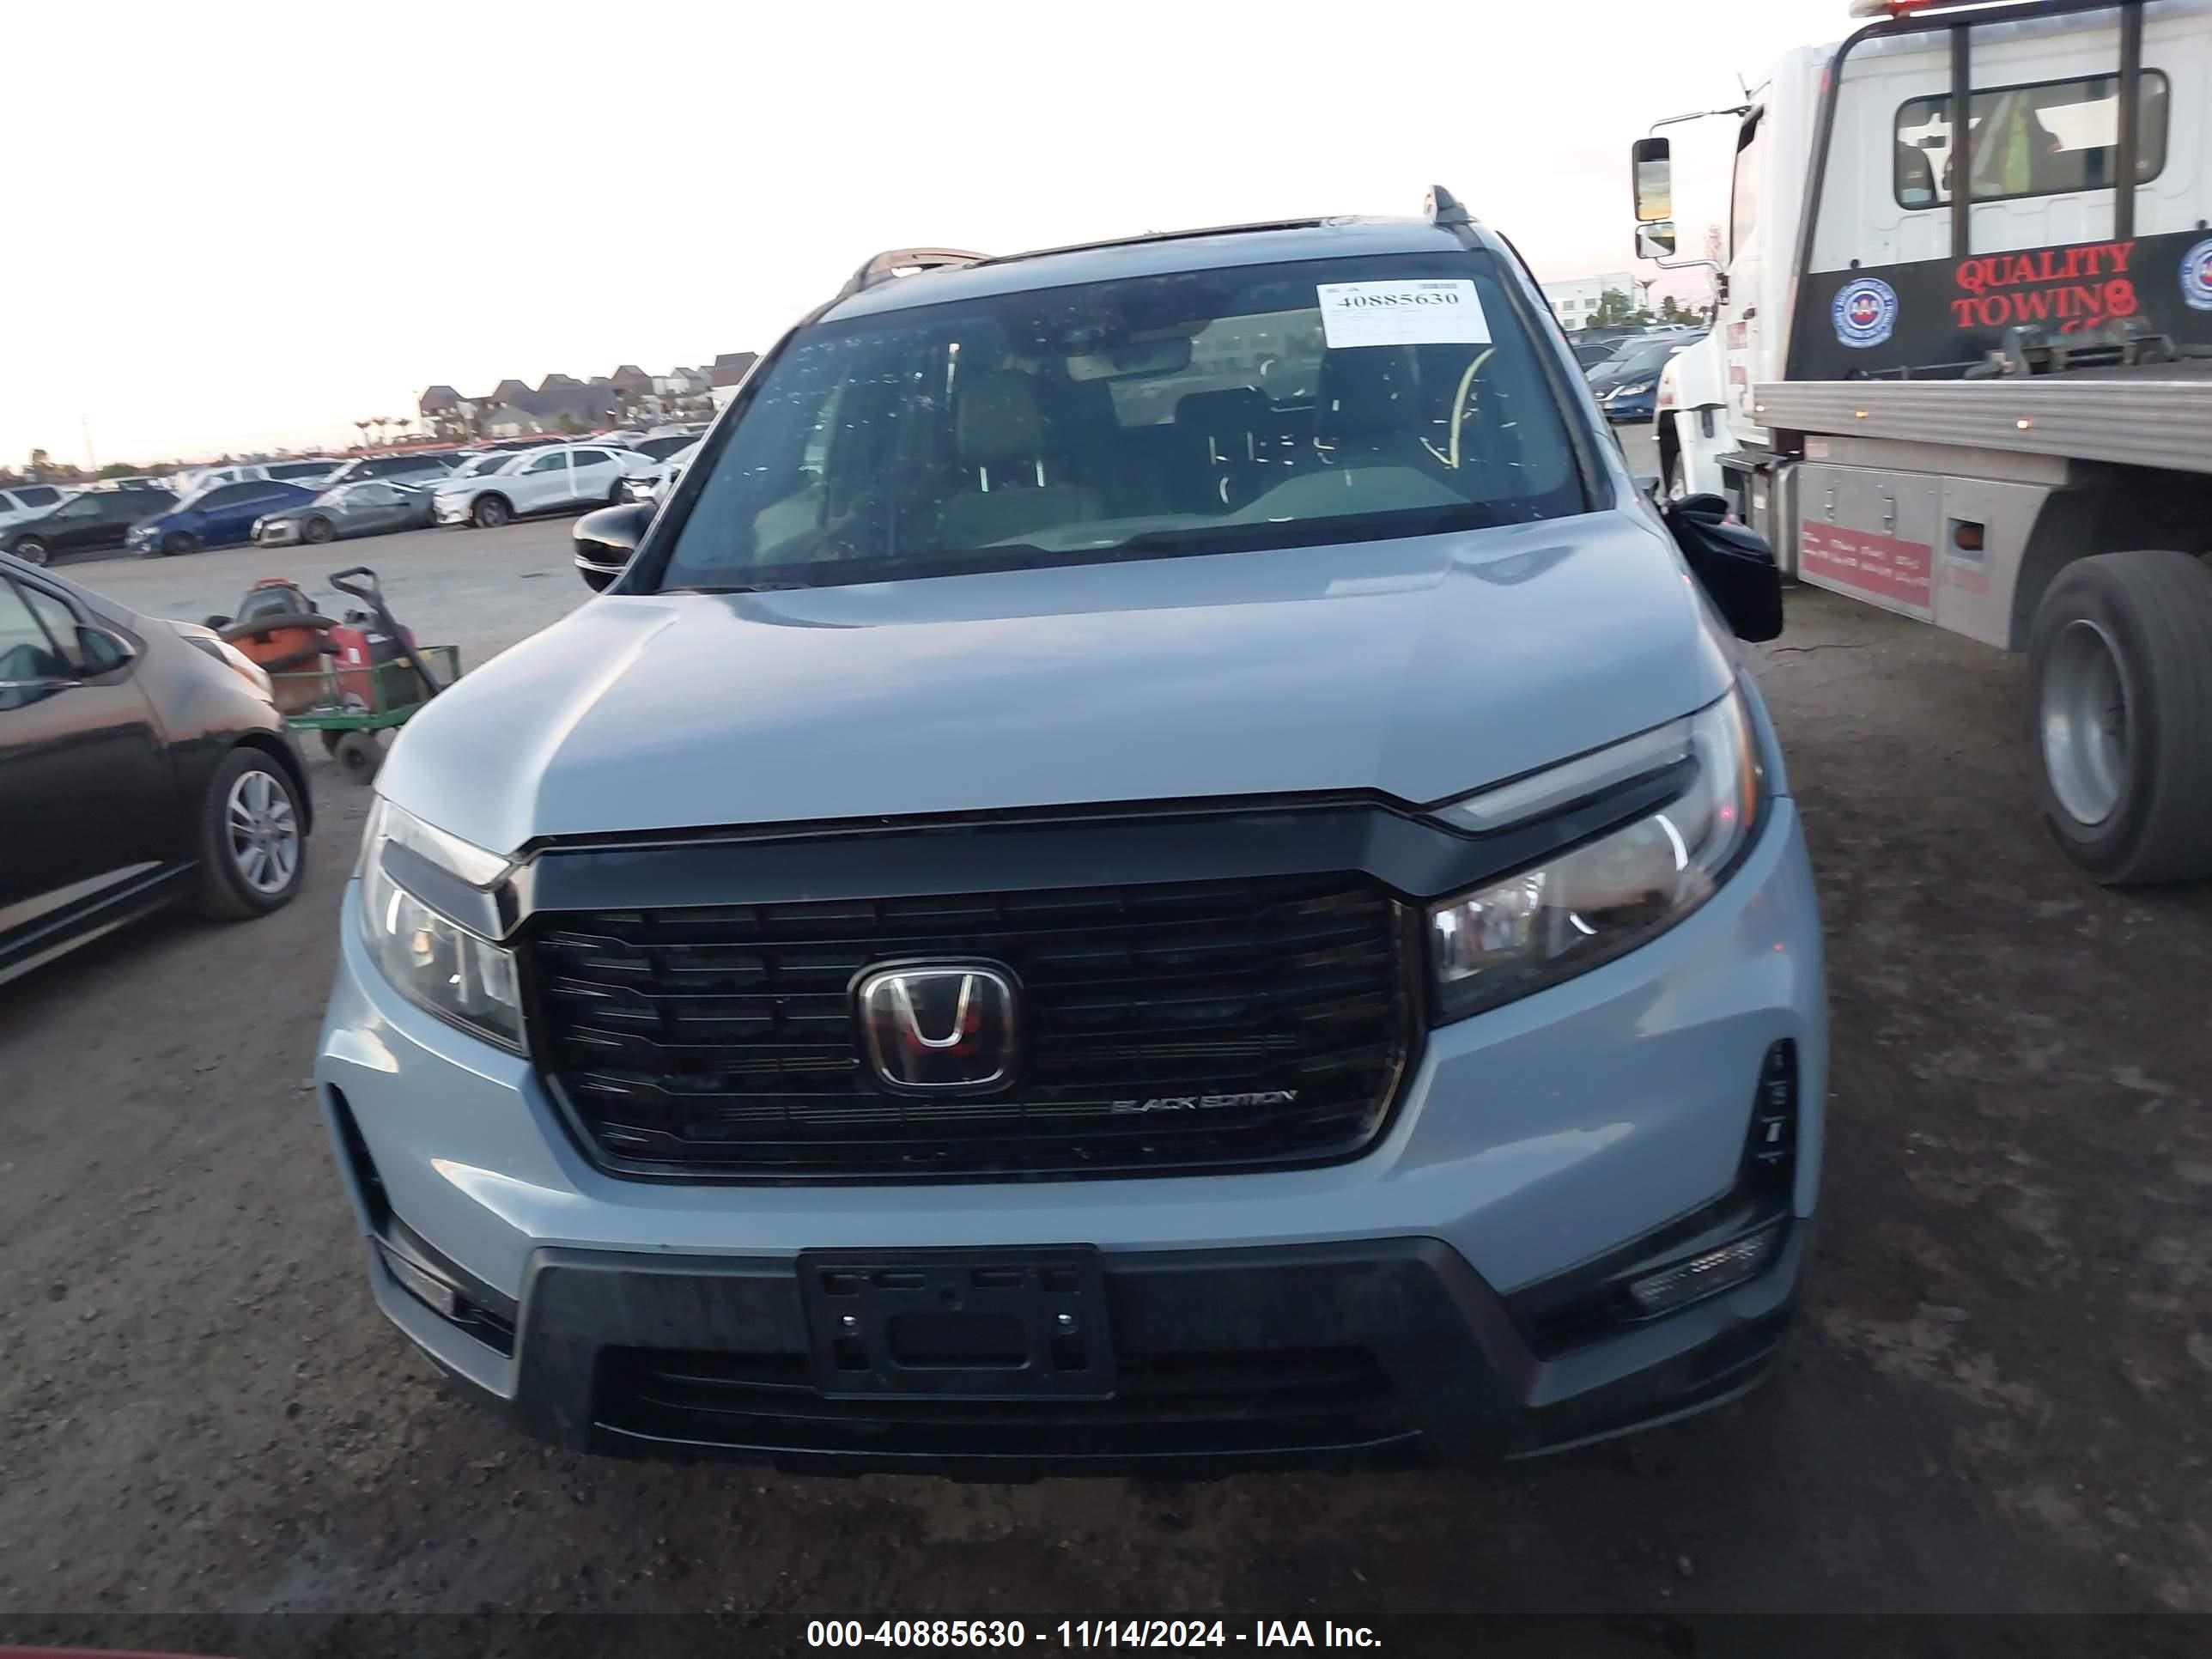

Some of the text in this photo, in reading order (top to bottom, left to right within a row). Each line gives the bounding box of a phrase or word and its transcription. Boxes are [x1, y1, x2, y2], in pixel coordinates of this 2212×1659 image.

[1955, 241, 2136, 295] QUALITY
[1338, 292, 1460, 308] 40885630
[1112, 1096, 1198, 1114] BLACK
